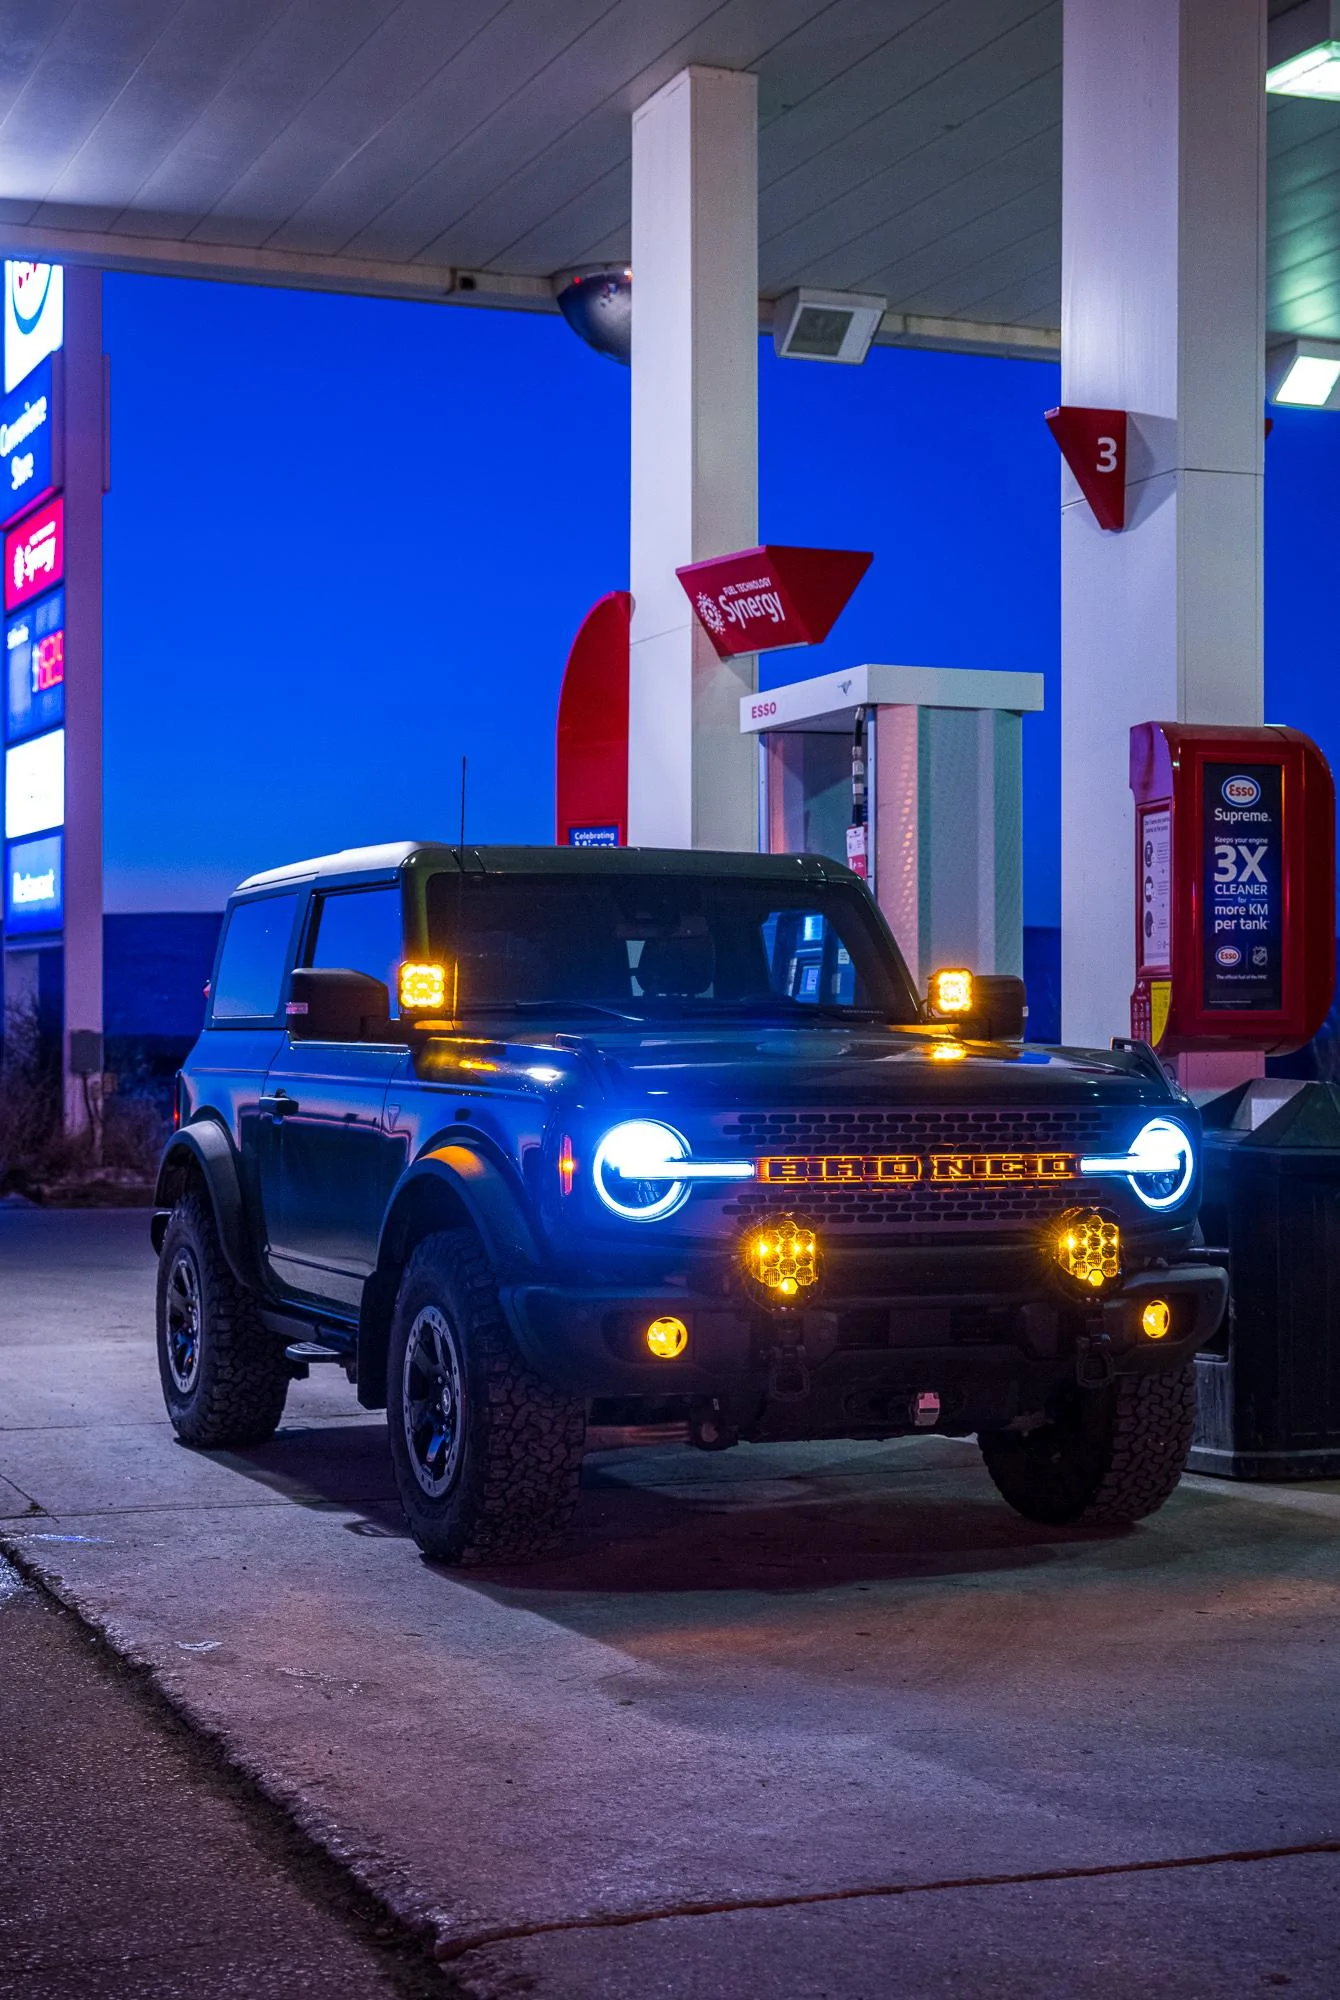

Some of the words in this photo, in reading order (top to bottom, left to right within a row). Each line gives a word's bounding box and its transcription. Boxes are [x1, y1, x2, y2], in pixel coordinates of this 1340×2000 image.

[1096, 437, 1117, 473] 3
[718, 591, 785, 629] Synergy
[752, 702, 776, 719] ESSO
[1228, 784, 1255, 797] Esso
[574, 831, 615, 841] Celebrating
[1214, 836, 1234, 844] Keeps
[1234, 837, 1248, 845] your
[1248, 837, 1269, 845] engine
[1214, 845, 1268, 883] 3X
[1214, 884, 1268, 895] CLEANER
[1214, 906, 1246, 915] more
[1249, 904, 1269, 916] KM
[1215, 920, 1238, 934] per
[1220, 951, 1238, 960] Esso
[765, 1154, 1070, 1183] BRONCO
